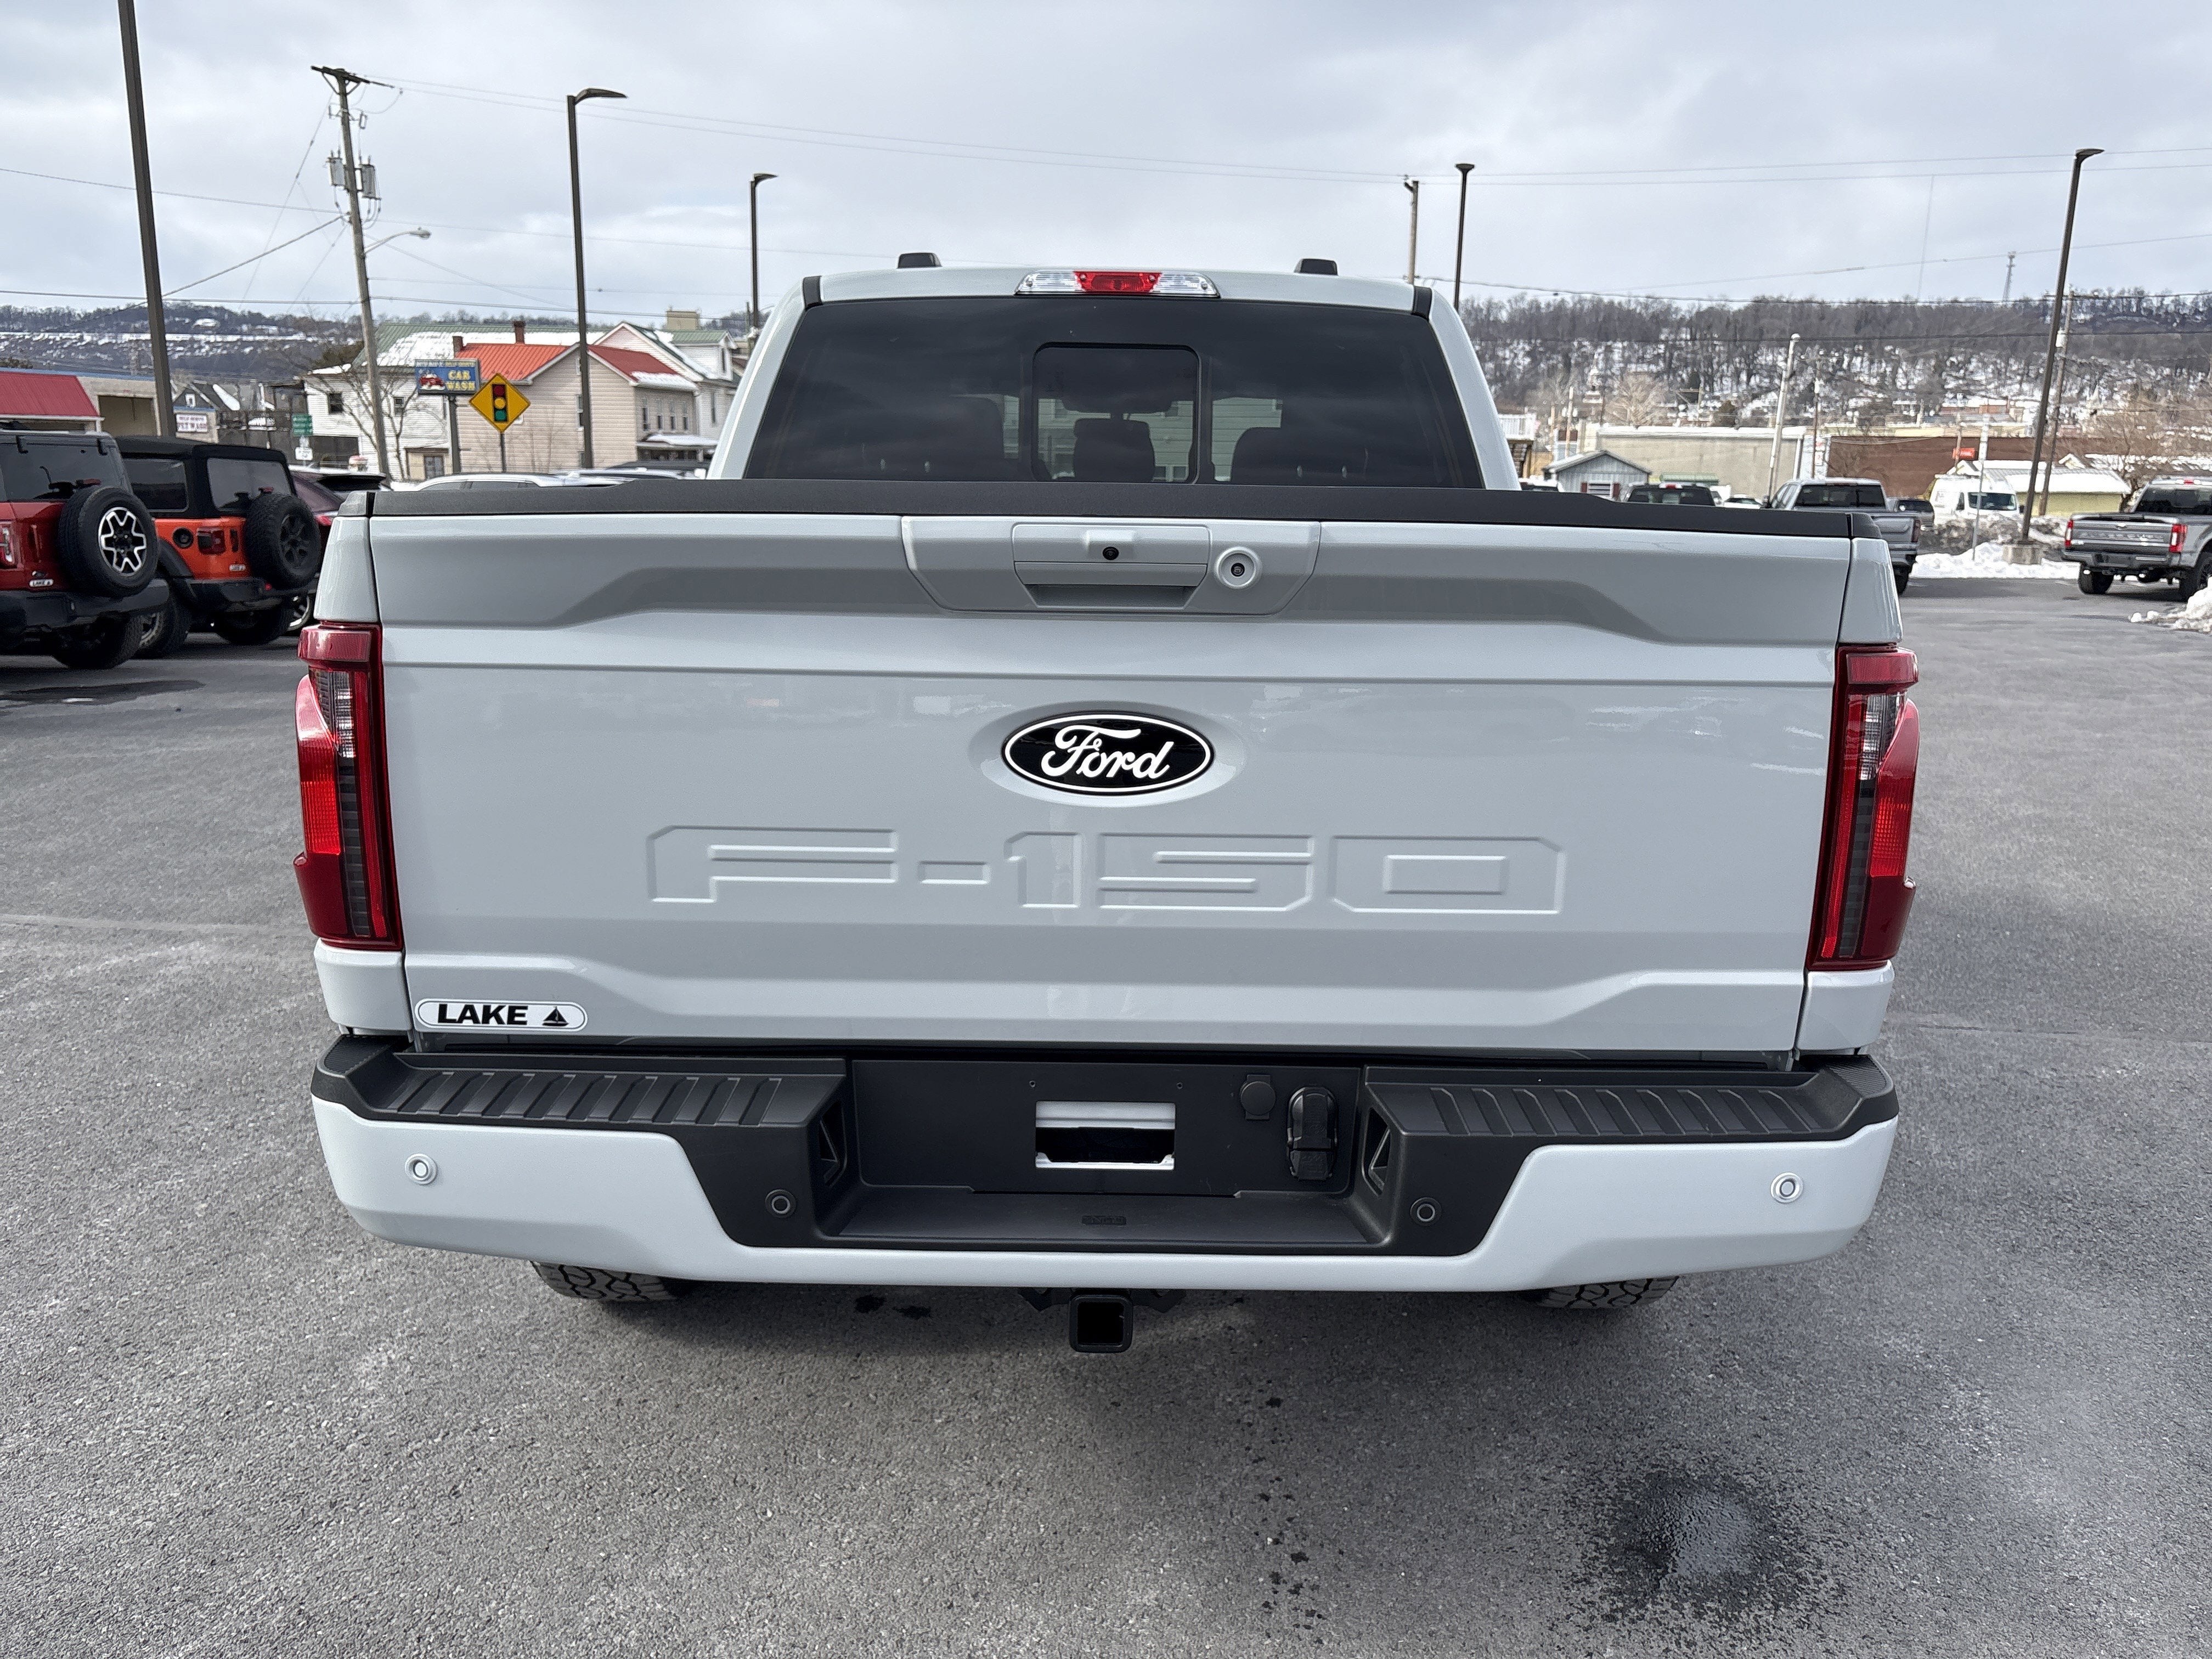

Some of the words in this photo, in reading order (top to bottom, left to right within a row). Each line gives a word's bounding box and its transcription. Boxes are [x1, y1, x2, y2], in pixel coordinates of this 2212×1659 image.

[445, 381, 475, 391] WASH
[448, 370, 470, 380] CAR
[1041, 725, 1175, 779] Ford
[646, 825, 1566, 915] F-150
[437, 1003, 529, 1025] LAKE
